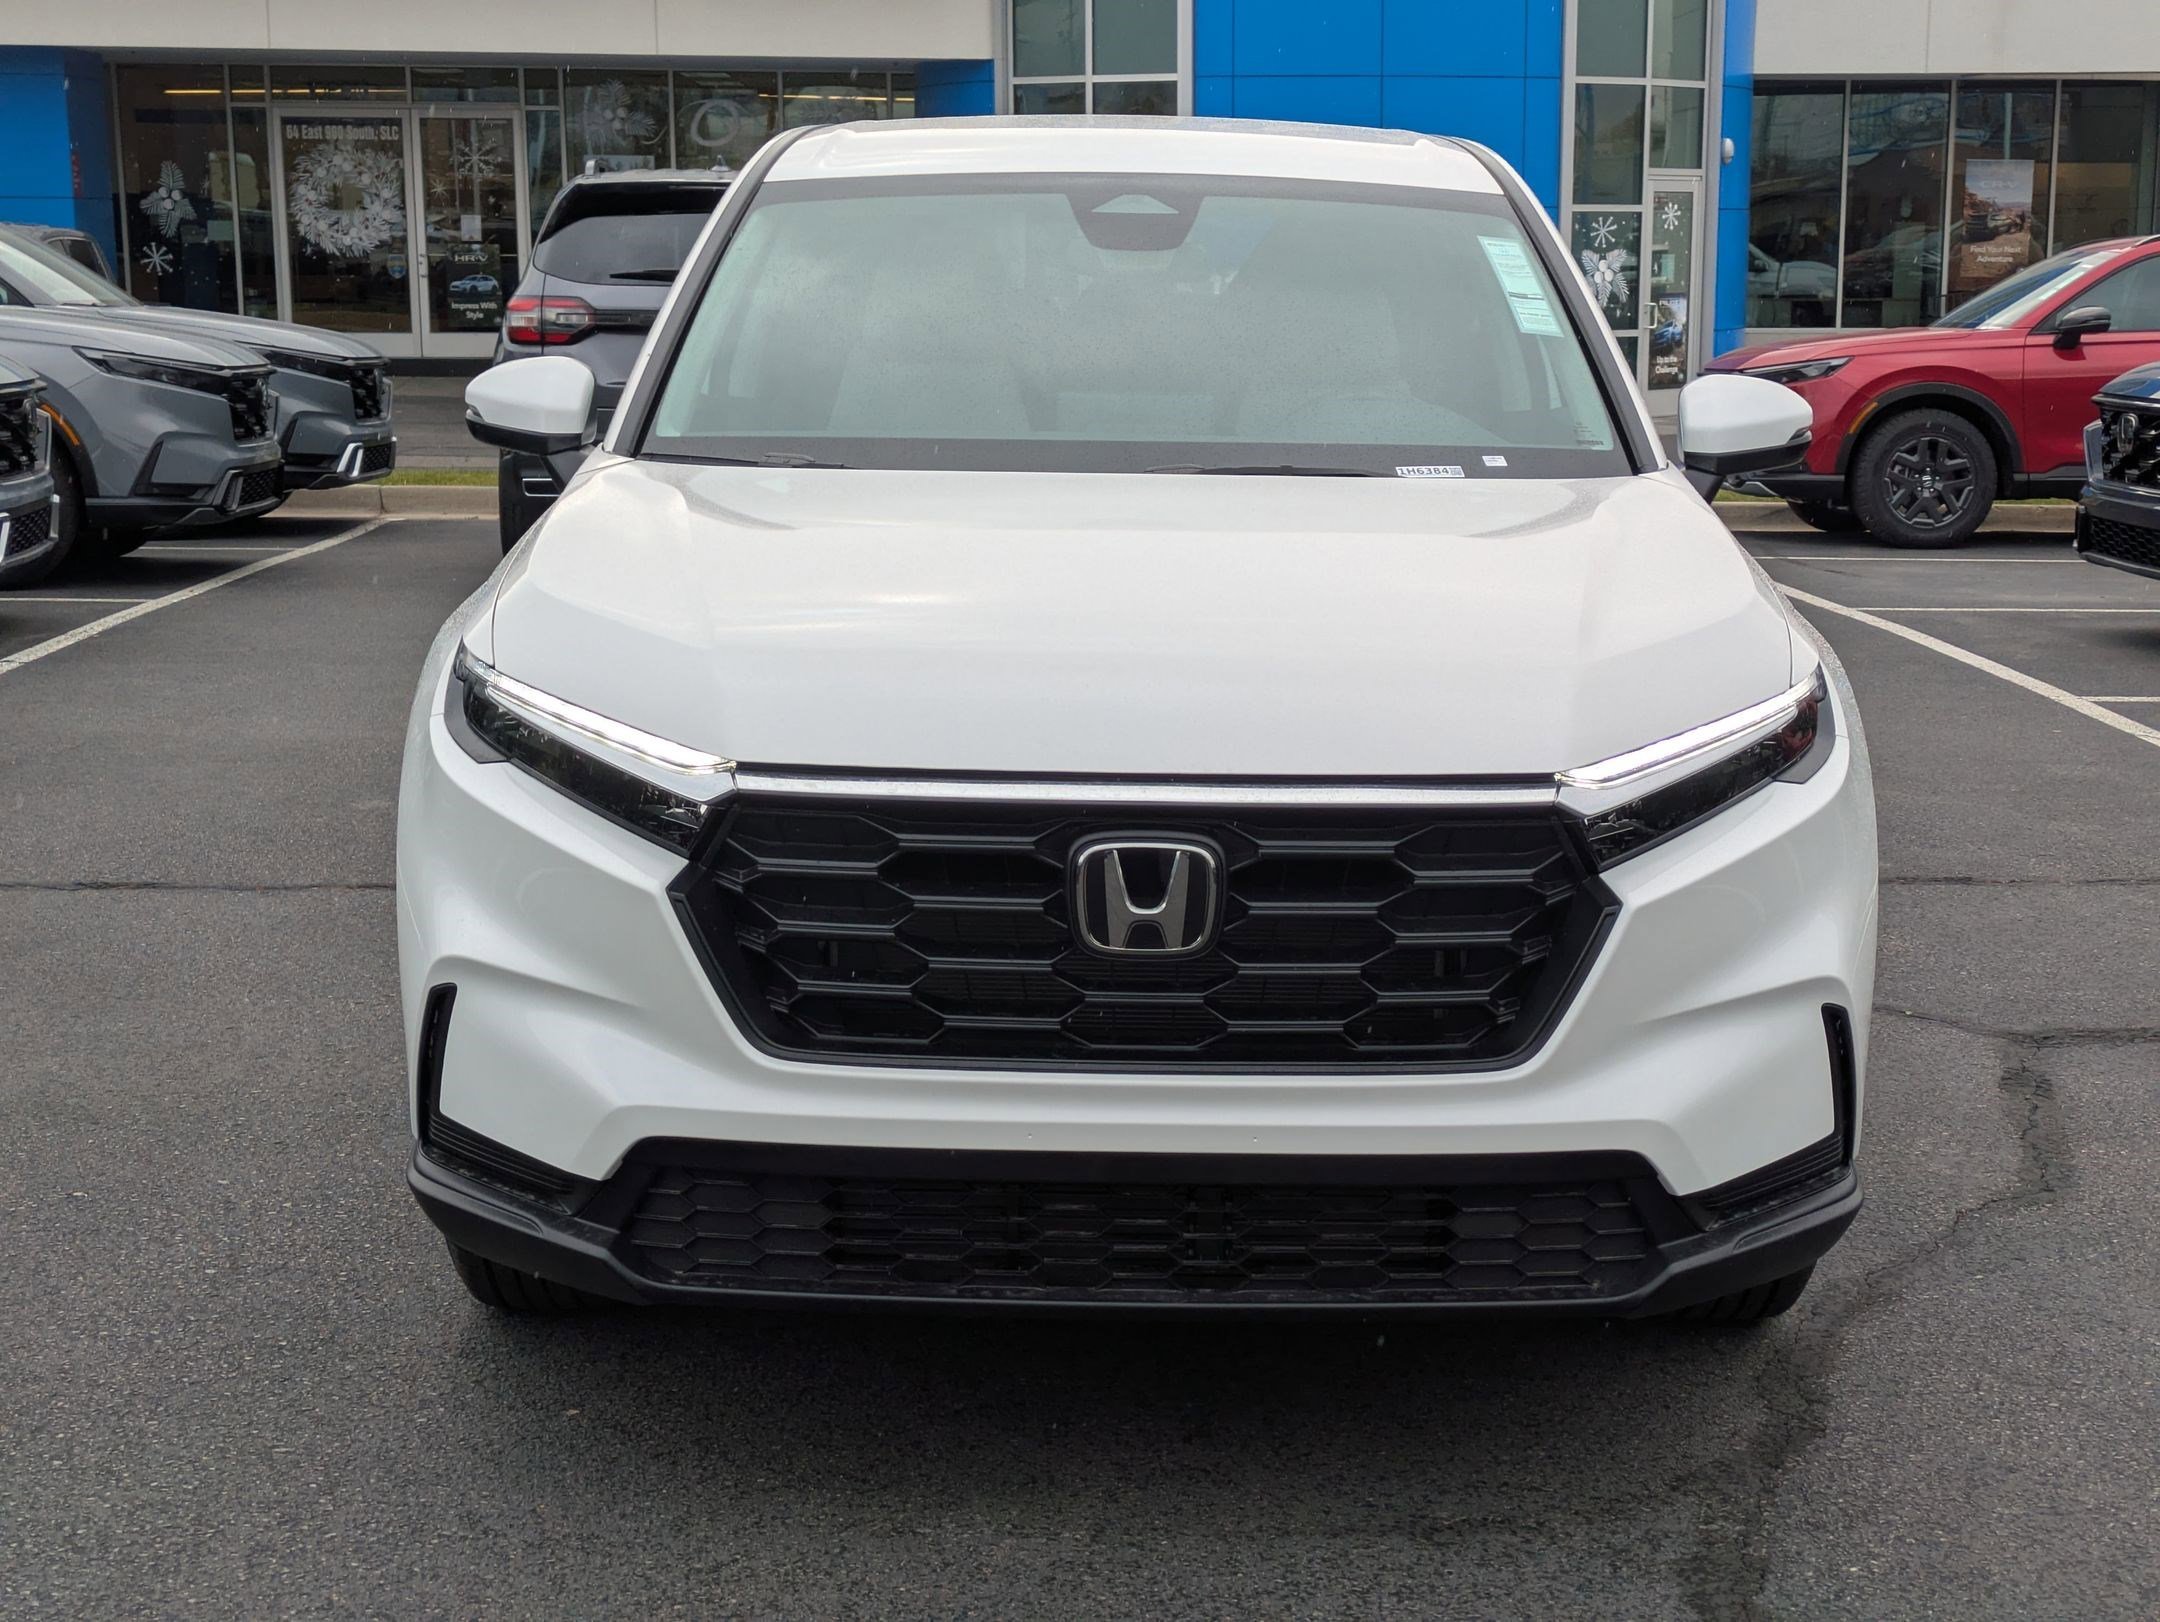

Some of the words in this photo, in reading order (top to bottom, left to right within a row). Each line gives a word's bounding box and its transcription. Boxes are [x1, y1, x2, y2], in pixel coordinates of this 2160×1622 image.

[286, 125, 299, 139] 64
[301, 125, 322, 139] East
[379, 125, 399, 140] SLC
[1970, 245, 1986, 253] Find
[455, 254, 488, 262] HR-V
[451, 302, 479, 311] Impress
[480, 302, 498, 310] With
[465, 311, 484, 320] Style
[1398, 467, 1449, 475] 1H6384
